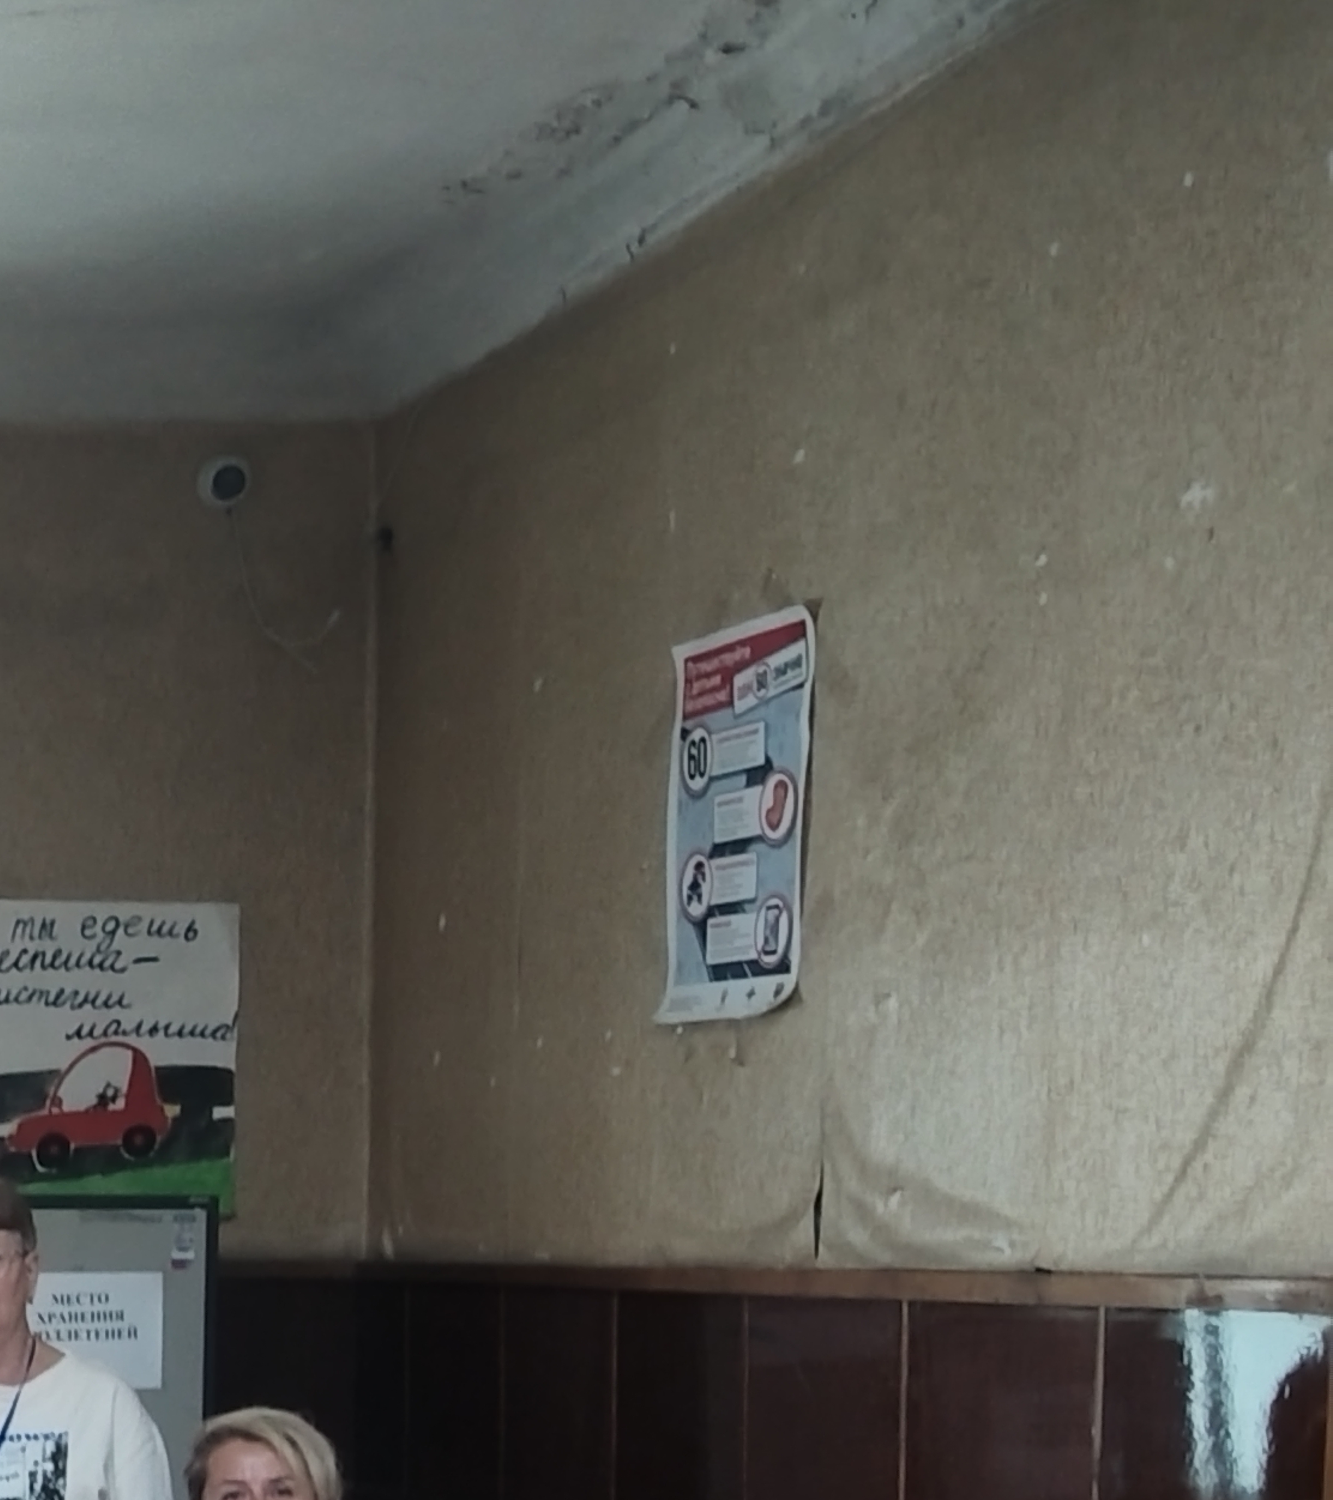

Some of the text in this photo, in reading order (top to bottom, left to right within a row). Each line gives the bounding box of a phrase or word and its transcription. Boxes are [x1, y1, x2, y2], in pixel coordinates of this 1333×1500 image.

[687, 736, 708, 781] 60
[11, 915, 57, 943] ты
[80, 914, 199, 951] едешь
[51, 1292, 110, 1307] МЕСТО
